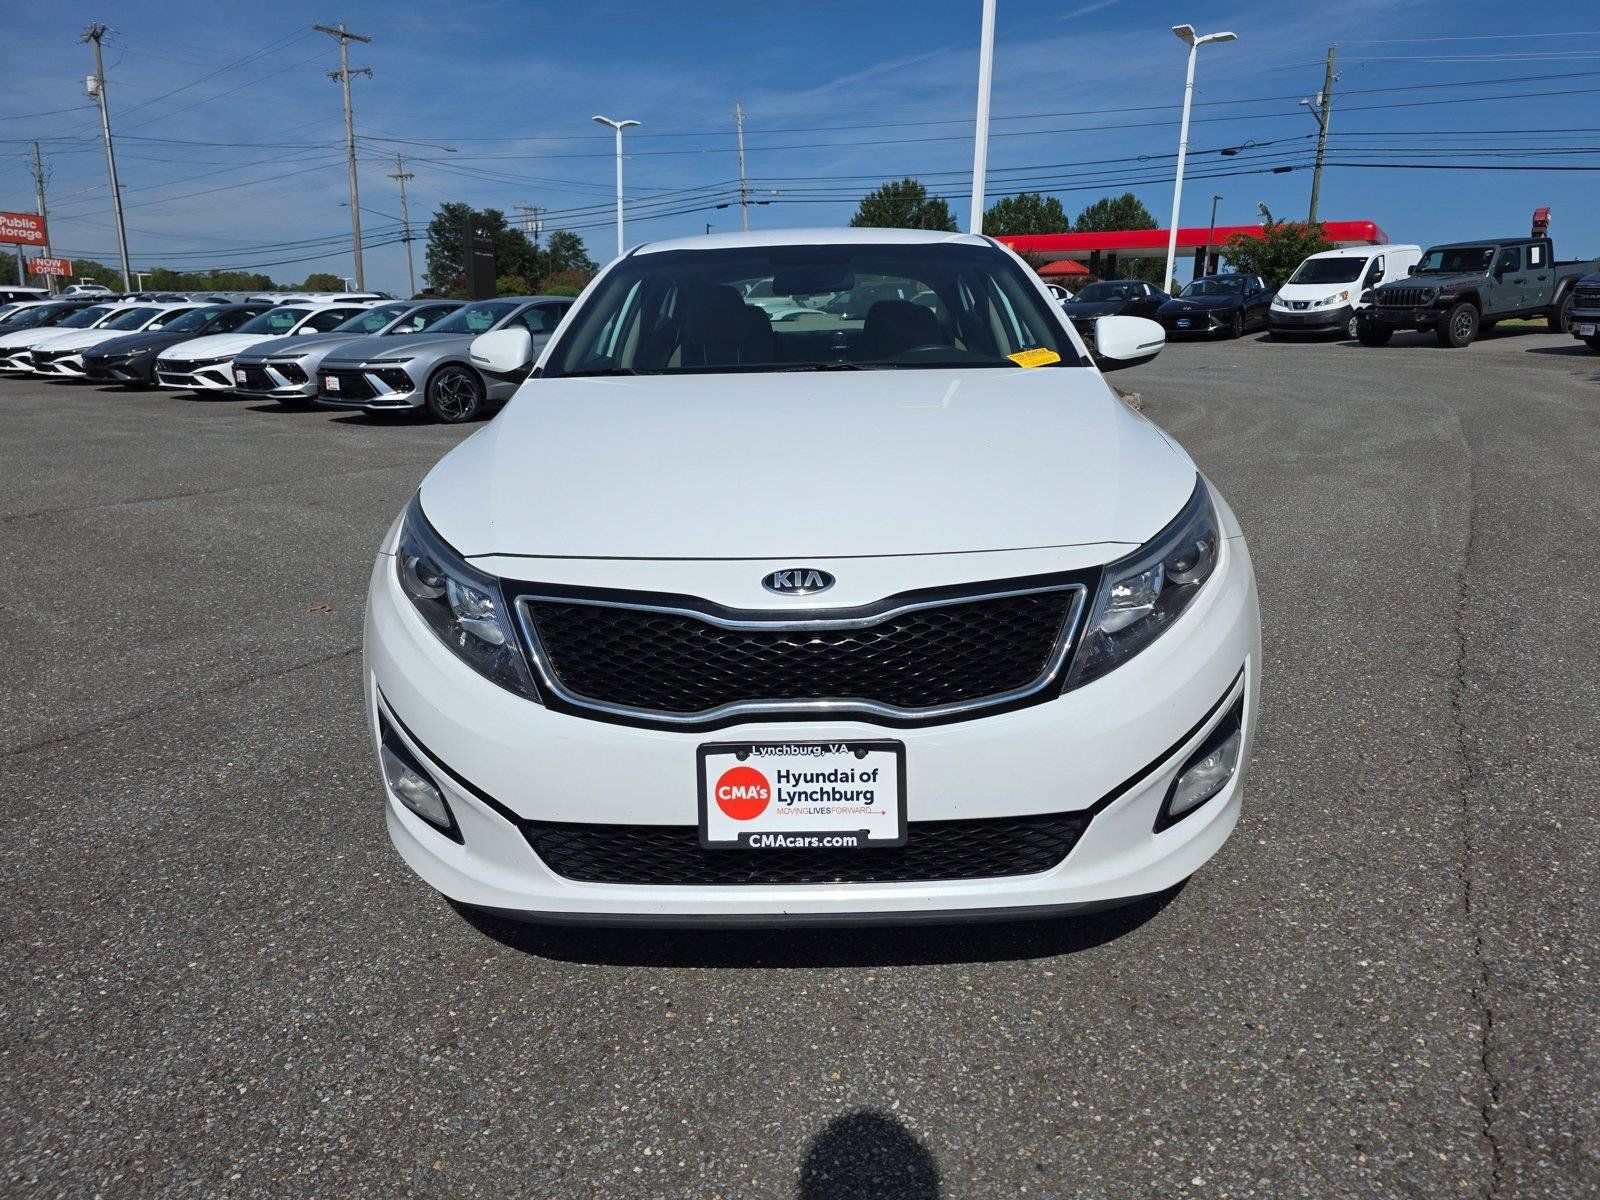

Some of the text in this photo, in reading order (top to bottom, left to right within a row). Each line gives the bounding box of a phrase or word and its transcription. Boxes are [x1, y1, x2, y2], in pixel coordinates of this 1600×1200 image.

[0, 216, 37, 229] Public
[36, 258, 61, 267] NOW
[36, 266, 64, 275] OPEN
[774, 571, 824, 588] KIA
[752, 744, 849, 757] Lynchburg, VA
[777, 768, 879, 787] Hyundai of
[718, 785, 768, 800] CMA's
[777, 787, 875, 806] Lynchburg
[749, 834, 858, 848] CMAcars.com
